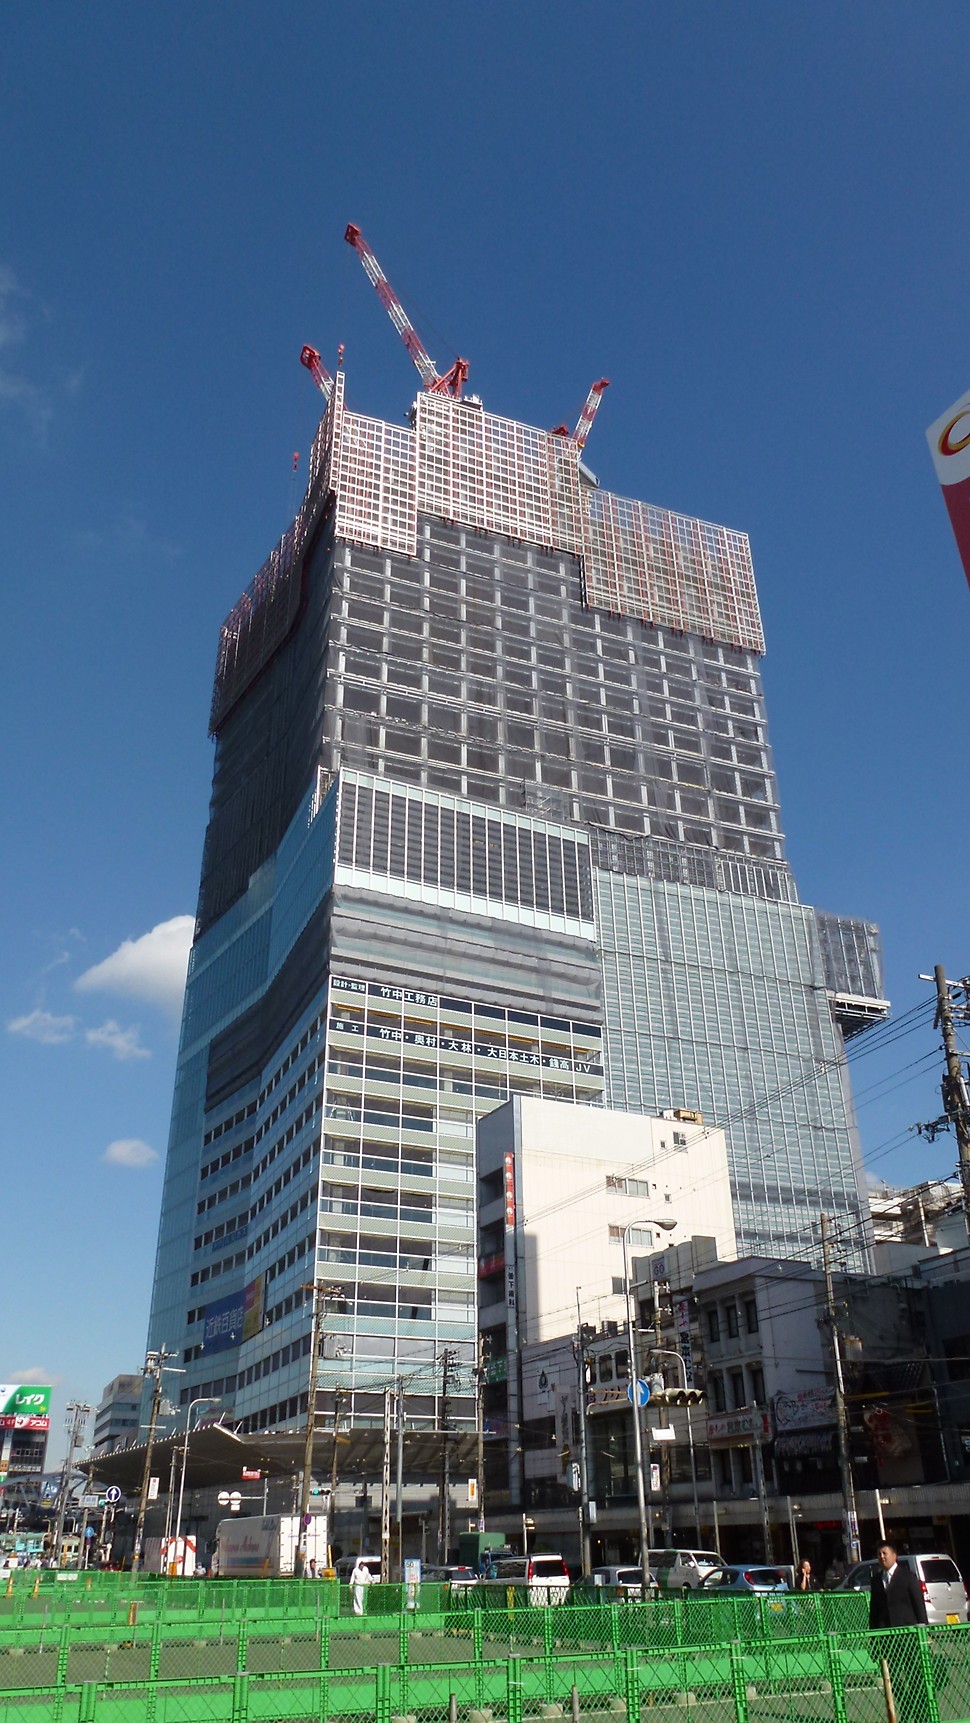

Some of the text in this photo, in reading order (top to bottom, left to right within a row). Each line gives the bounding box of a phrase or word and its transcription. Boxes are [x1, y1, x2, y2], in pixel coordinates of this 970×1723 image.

[380, 987, 438, 1007] 竹中工務店
[575, 1063, 591, 1073] JV
[15, 1393, 46, 1405] レイク
[30, 1419, 48, 1427] アコム
